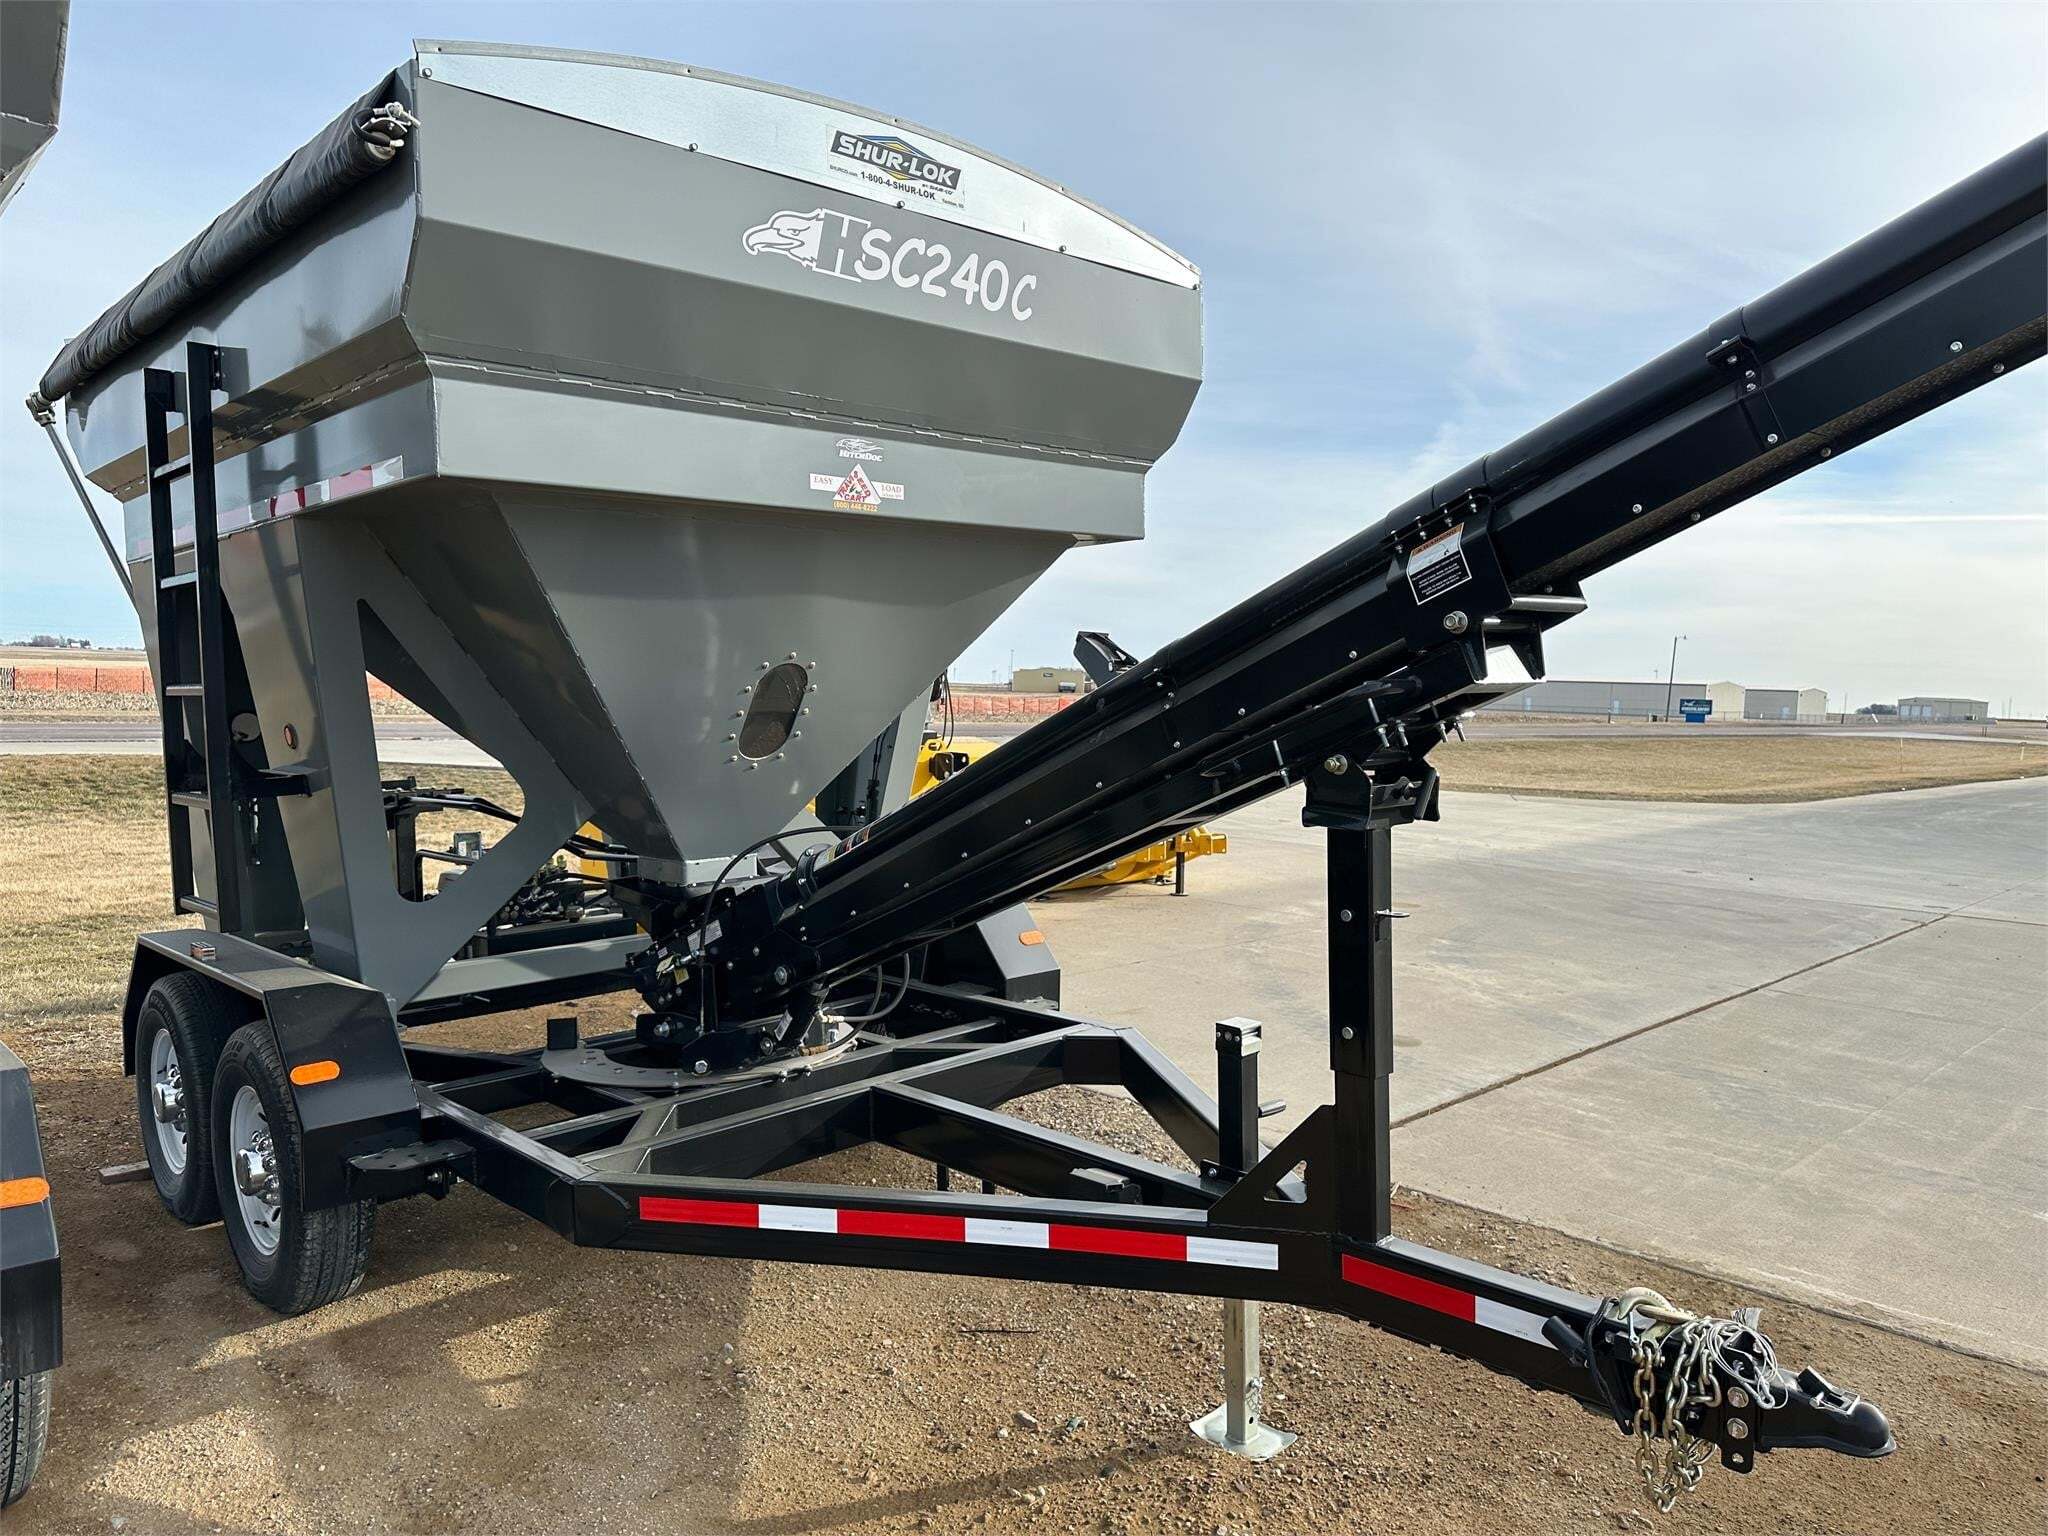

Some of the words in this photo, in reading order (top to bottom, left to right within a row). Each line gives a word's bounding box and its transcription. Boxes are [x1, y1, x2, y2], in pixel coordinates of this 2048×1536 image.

[837, 134, 956, 187] SHUR-LOK
[860, 170, 936, 201] 1-800-4-SHUR-LOK
[813, 475, 834, 486] EASY
[880, 484, 902, 494] LOAD
[844, 493, 867, 503] CART
